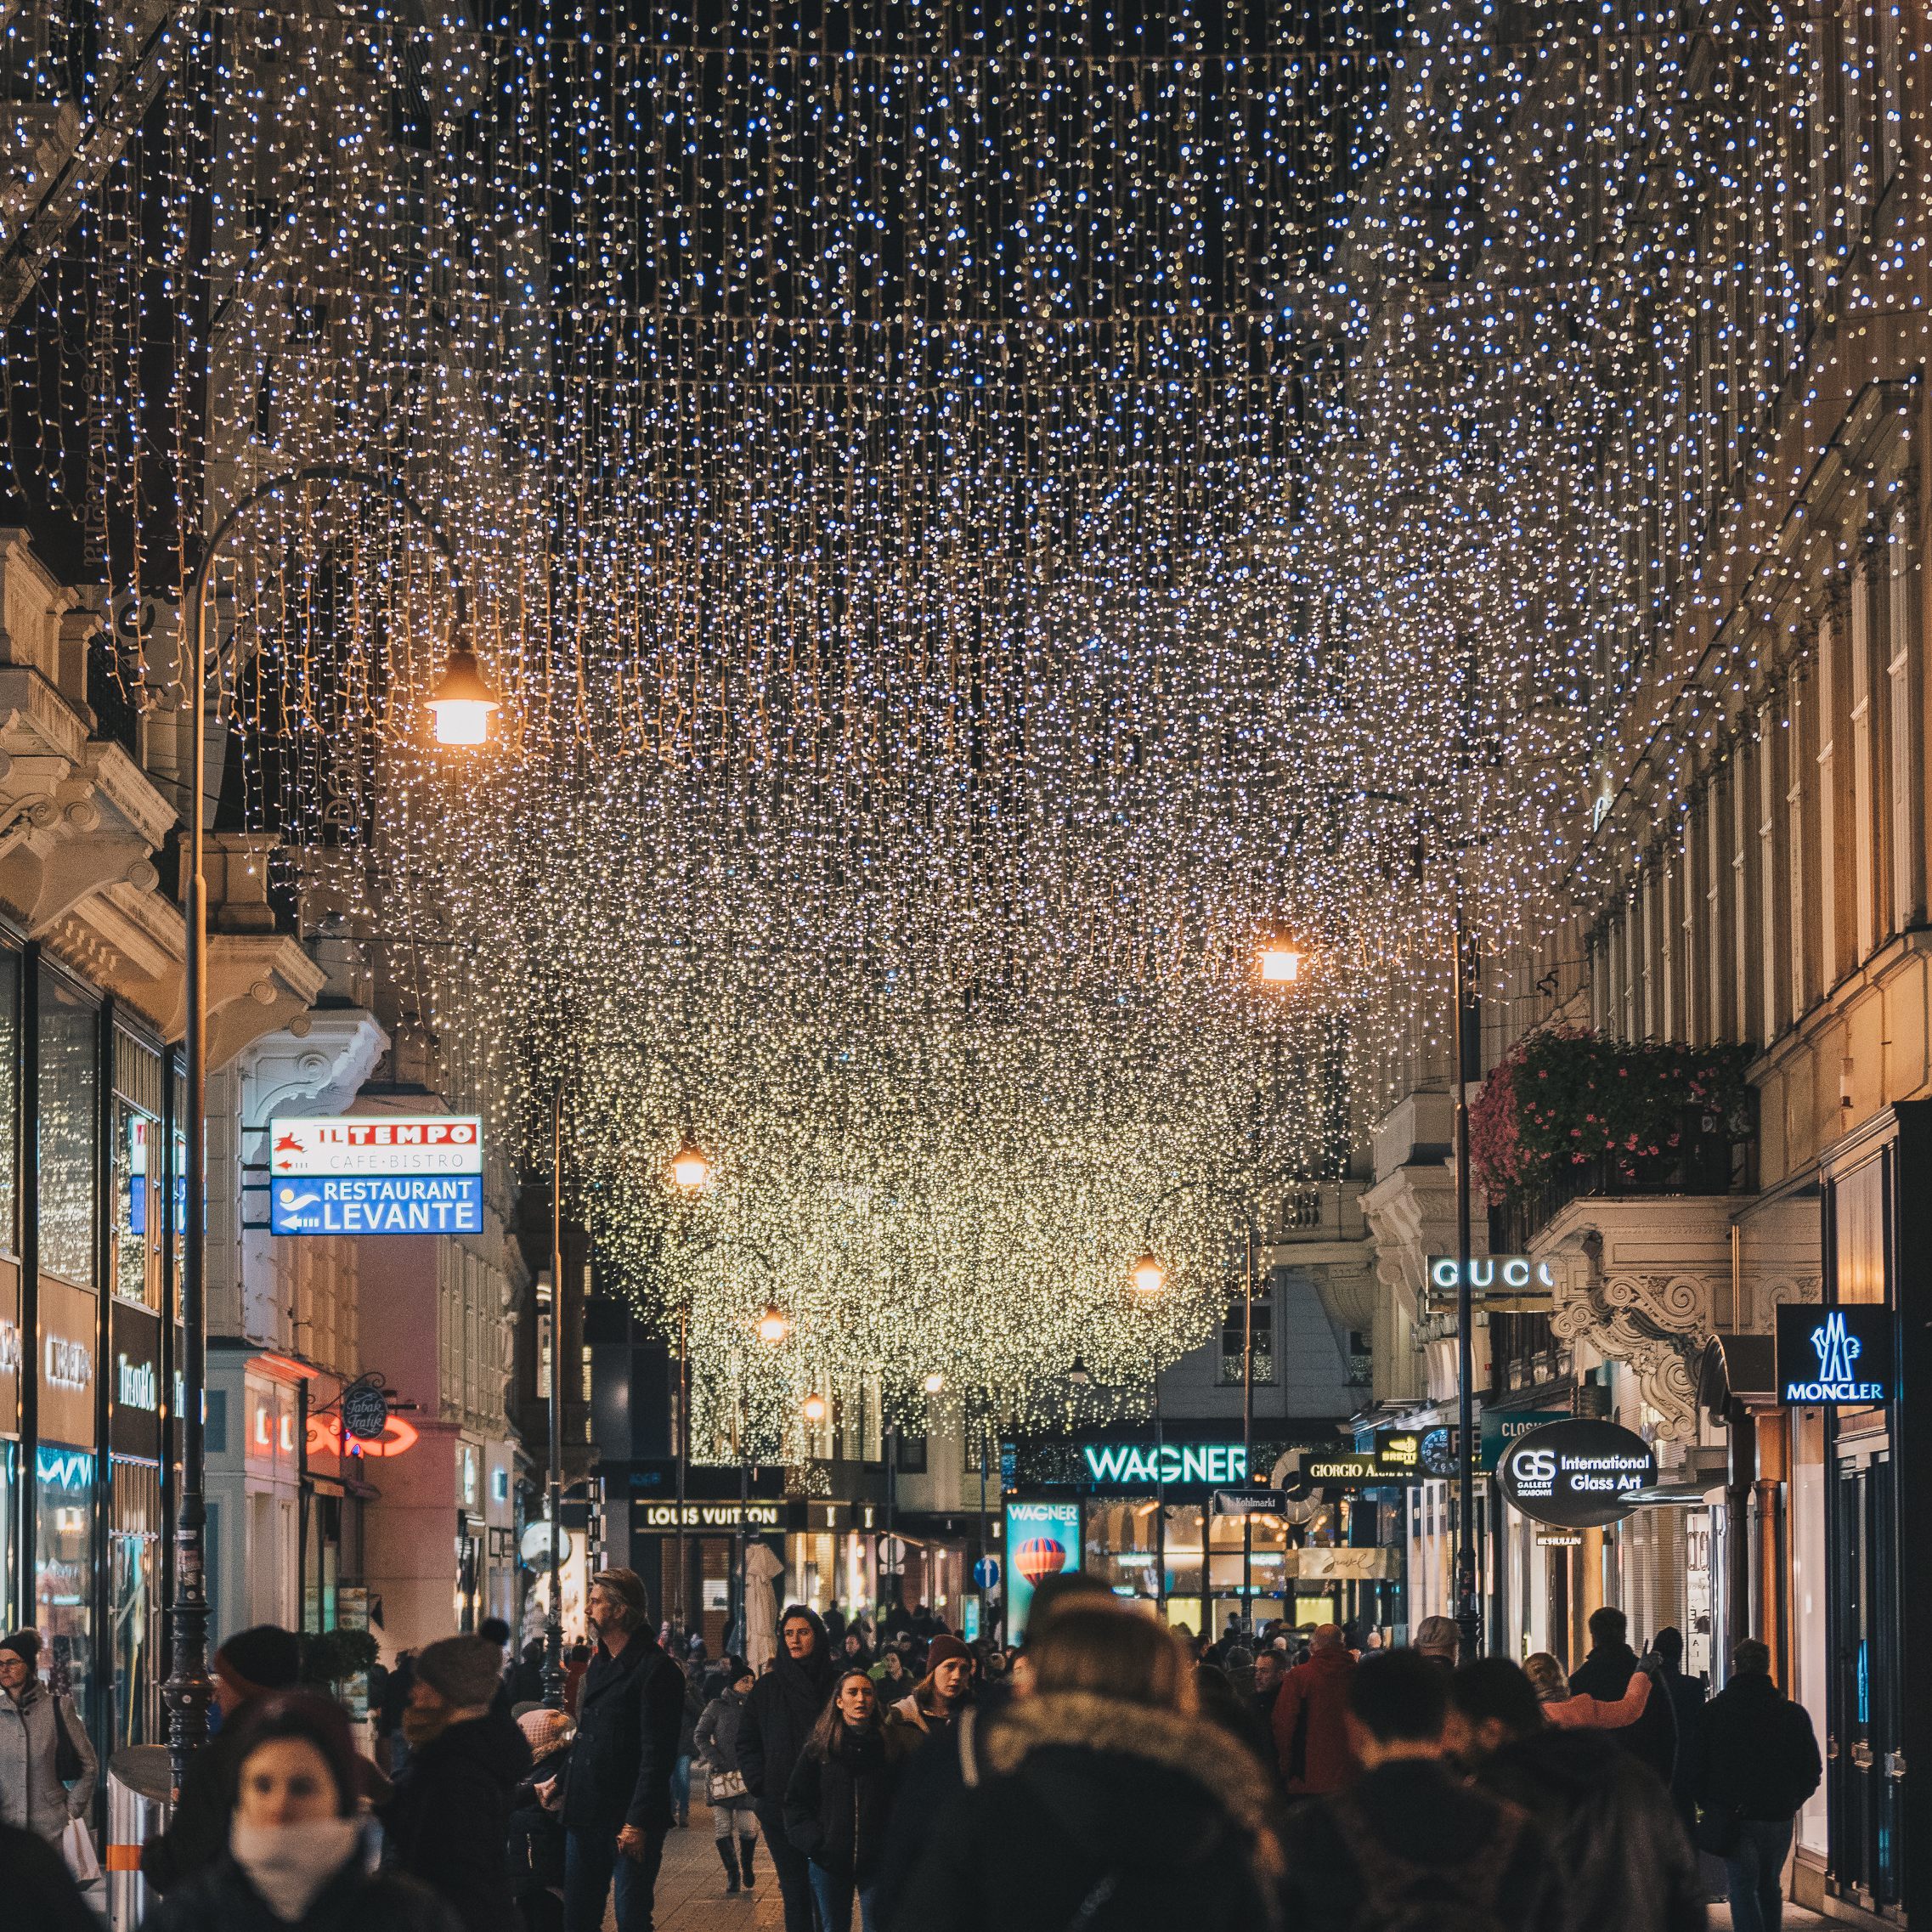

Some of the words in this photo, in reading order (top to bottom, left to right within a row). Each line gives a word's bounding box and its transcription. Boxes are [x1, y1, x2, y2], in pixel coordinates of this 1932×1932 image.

[76, 460, 114, 568] Zegna
[319, 1128, 343, 1143] IL
[350, 1126, 472, 1144] TEMPO
[324, 1181, 472, 1200] RESTAURANT
[324, 1202, 473, 1230] LEVANTE
[1787, 1383, 1884, 1400] MONCLER
[347, 1399, 384, 1415] Tabak
[347, 1413, 384, 1429] Trafik
[1084, 1445, 1247, 1483] WAGNER
[1310, 1464, 1363, 1477] GIORGIO
[1512, 1450, 1556, 1481] GS
[1562, 1455, 1650, 1470] International
[1570, 1474, 1614, 1490] Glass
[1616, 1474, 1641, 1490] Art
[1235, 1497, 1275, 1507] Kohlmarkt
[647, 1507, 698, 1525] LOUIS
[703, 1507, 778, 1525] VUITON
[1008, 1504, 1077, 1521] WAGNER
